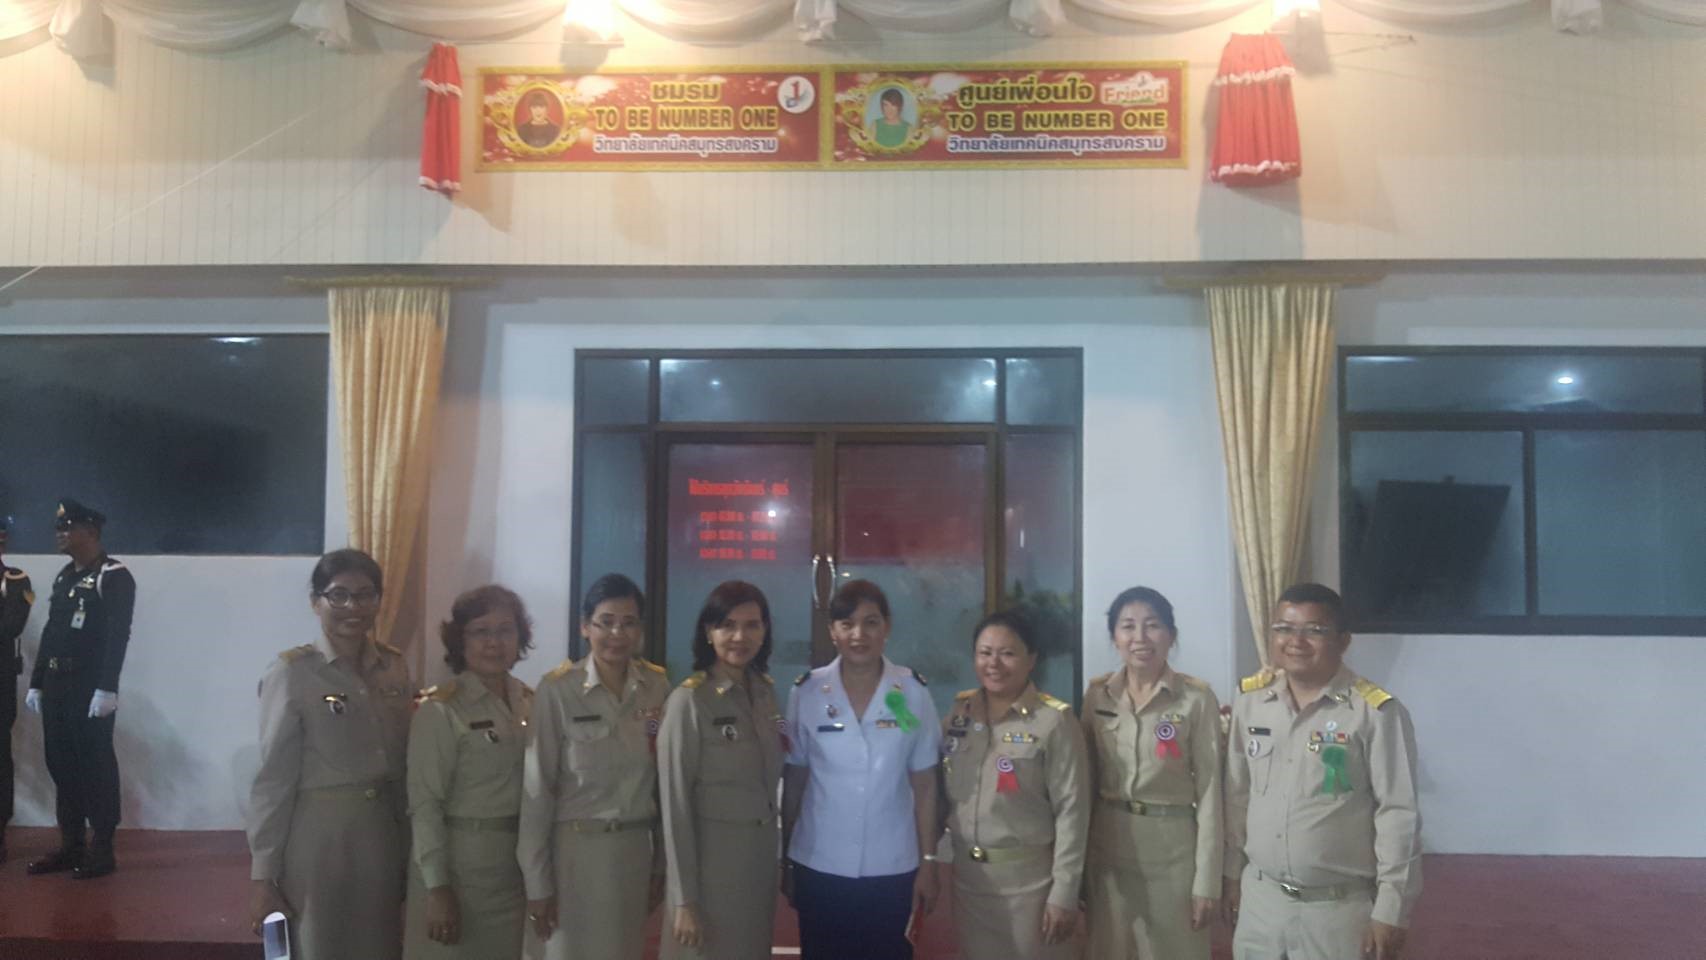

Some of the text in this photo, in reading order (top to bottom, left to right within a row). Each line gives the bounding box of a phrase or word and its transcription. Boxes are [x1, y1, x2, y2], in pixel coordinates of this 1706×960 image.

[652, 83, 720, 100] ชมรม
[959, 76, 1093, 107] ศูนย์เพื่อนใจ
[594, 107, 777, 129] TO BE NUMBER ONE
[948, 110, 1166, 129] TO BE NUMBER ONE
[594, 135, 777, 156] วิทยาลัยเทคนิคสมุทรสงคราม
[948, 135, 1165, 155] วิทยาลัยเทคนิคสมุทรสงคราม
